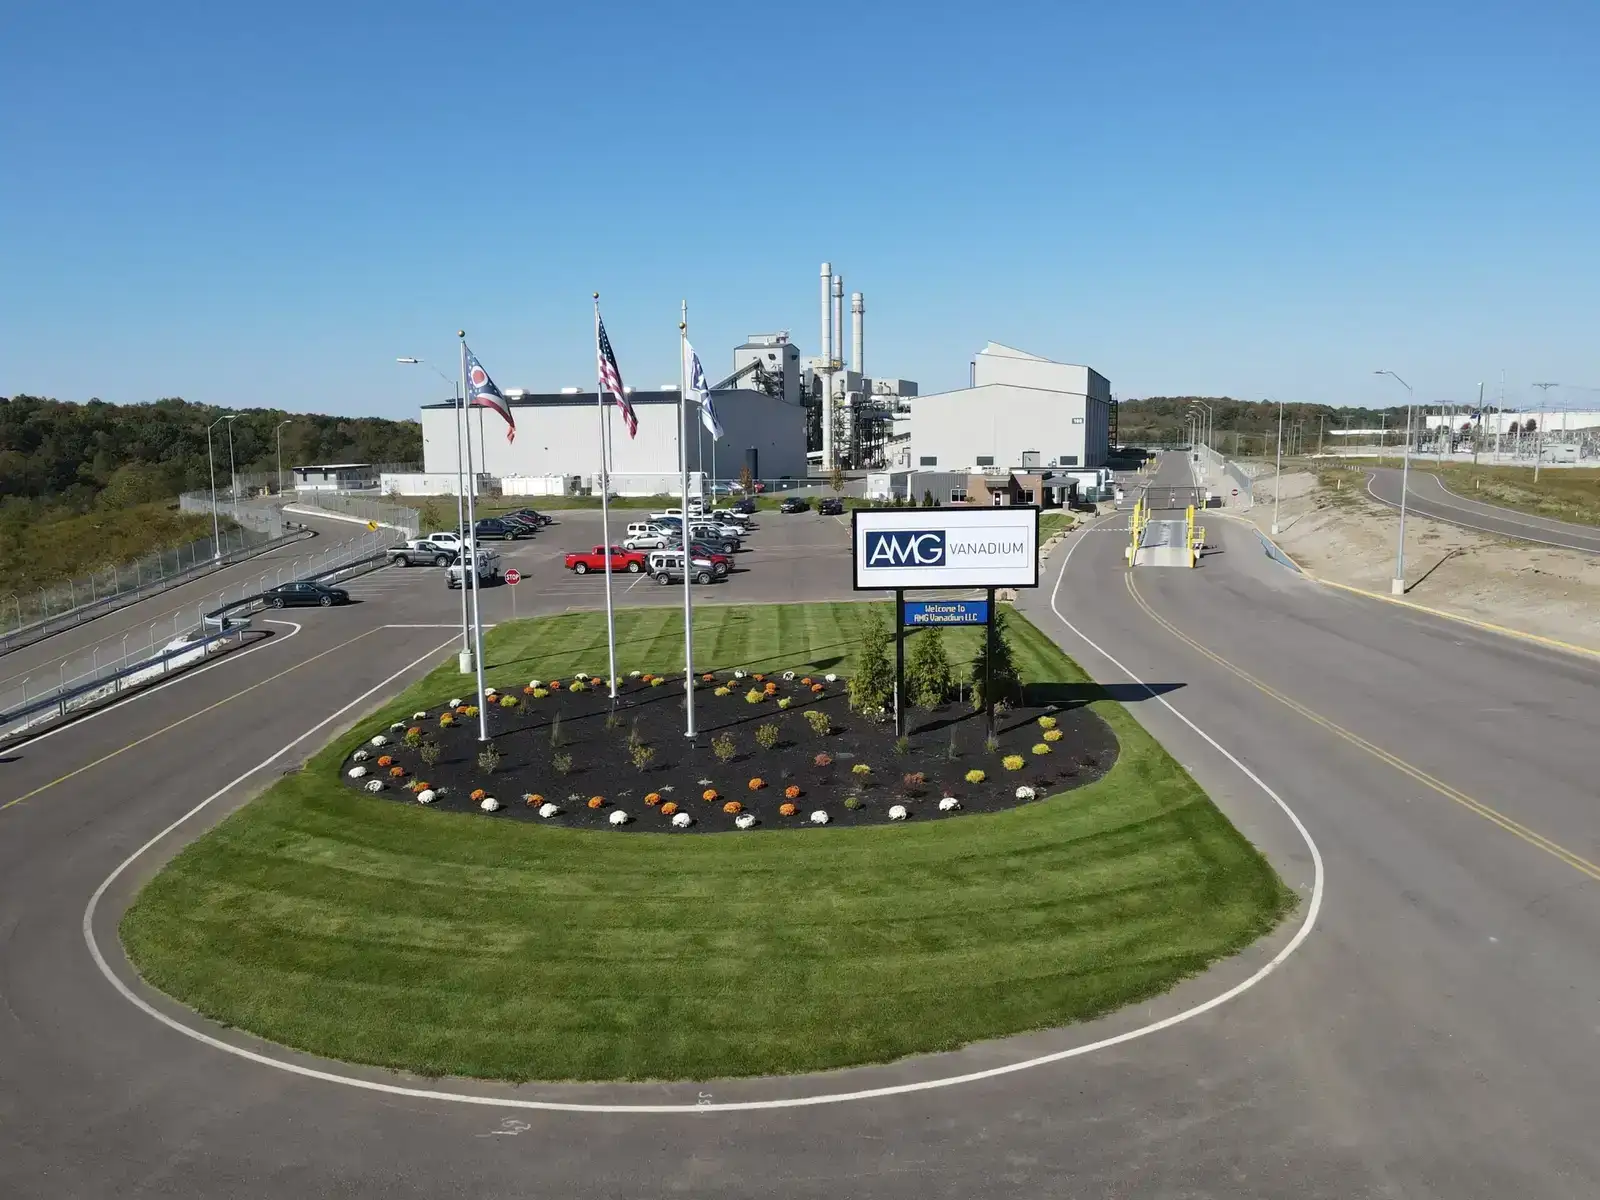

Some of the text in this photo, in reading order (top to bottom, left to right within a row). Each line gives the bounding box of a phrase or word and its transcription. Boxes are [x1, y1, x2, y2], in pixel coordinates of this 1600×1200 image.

[869, 533, 1024, 565] AMG VANADIUM
[914, 614, 929, 622] AMG
[965, 613, 978, 621] LLC
